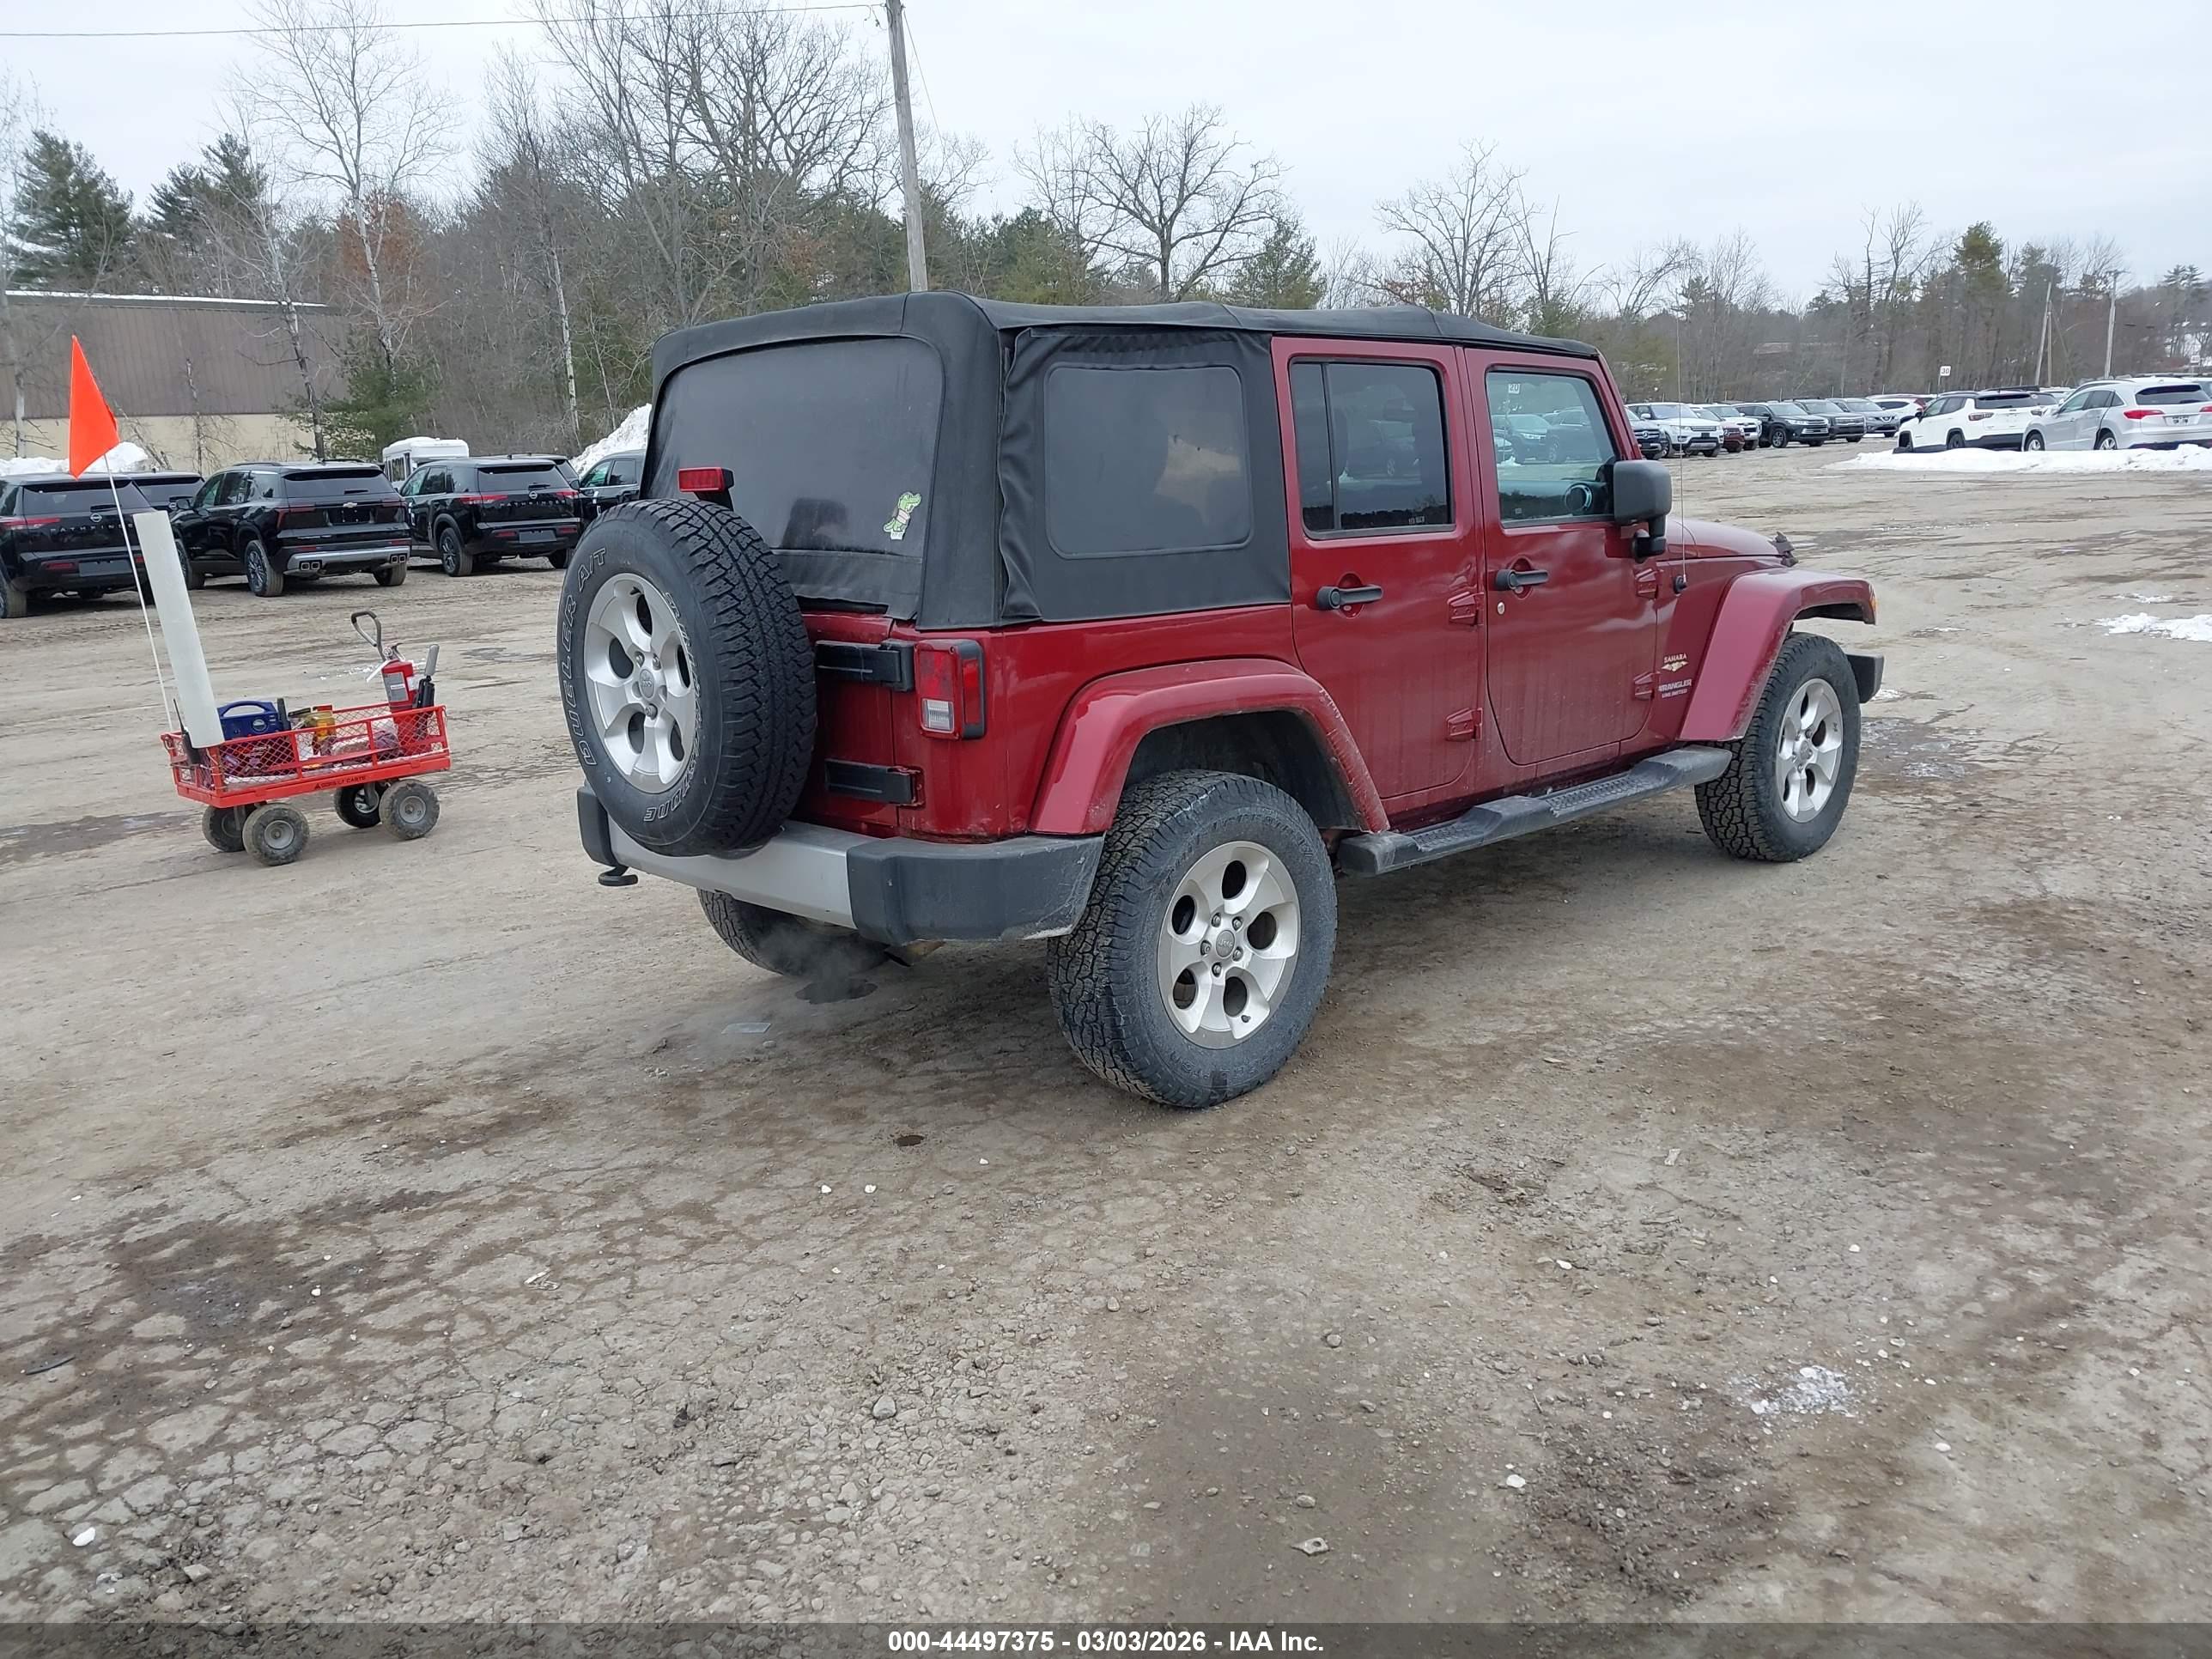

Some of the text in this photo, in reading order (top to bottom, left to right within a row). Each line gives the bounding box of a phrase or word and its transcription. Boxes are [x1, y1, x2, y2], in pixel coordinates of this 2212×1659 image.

[562, 548, 606, 765] DUELER A/T
[1663, 653, 1686, 663] SAHARA
[1658, 678, 1692, 691] WRANGLER
